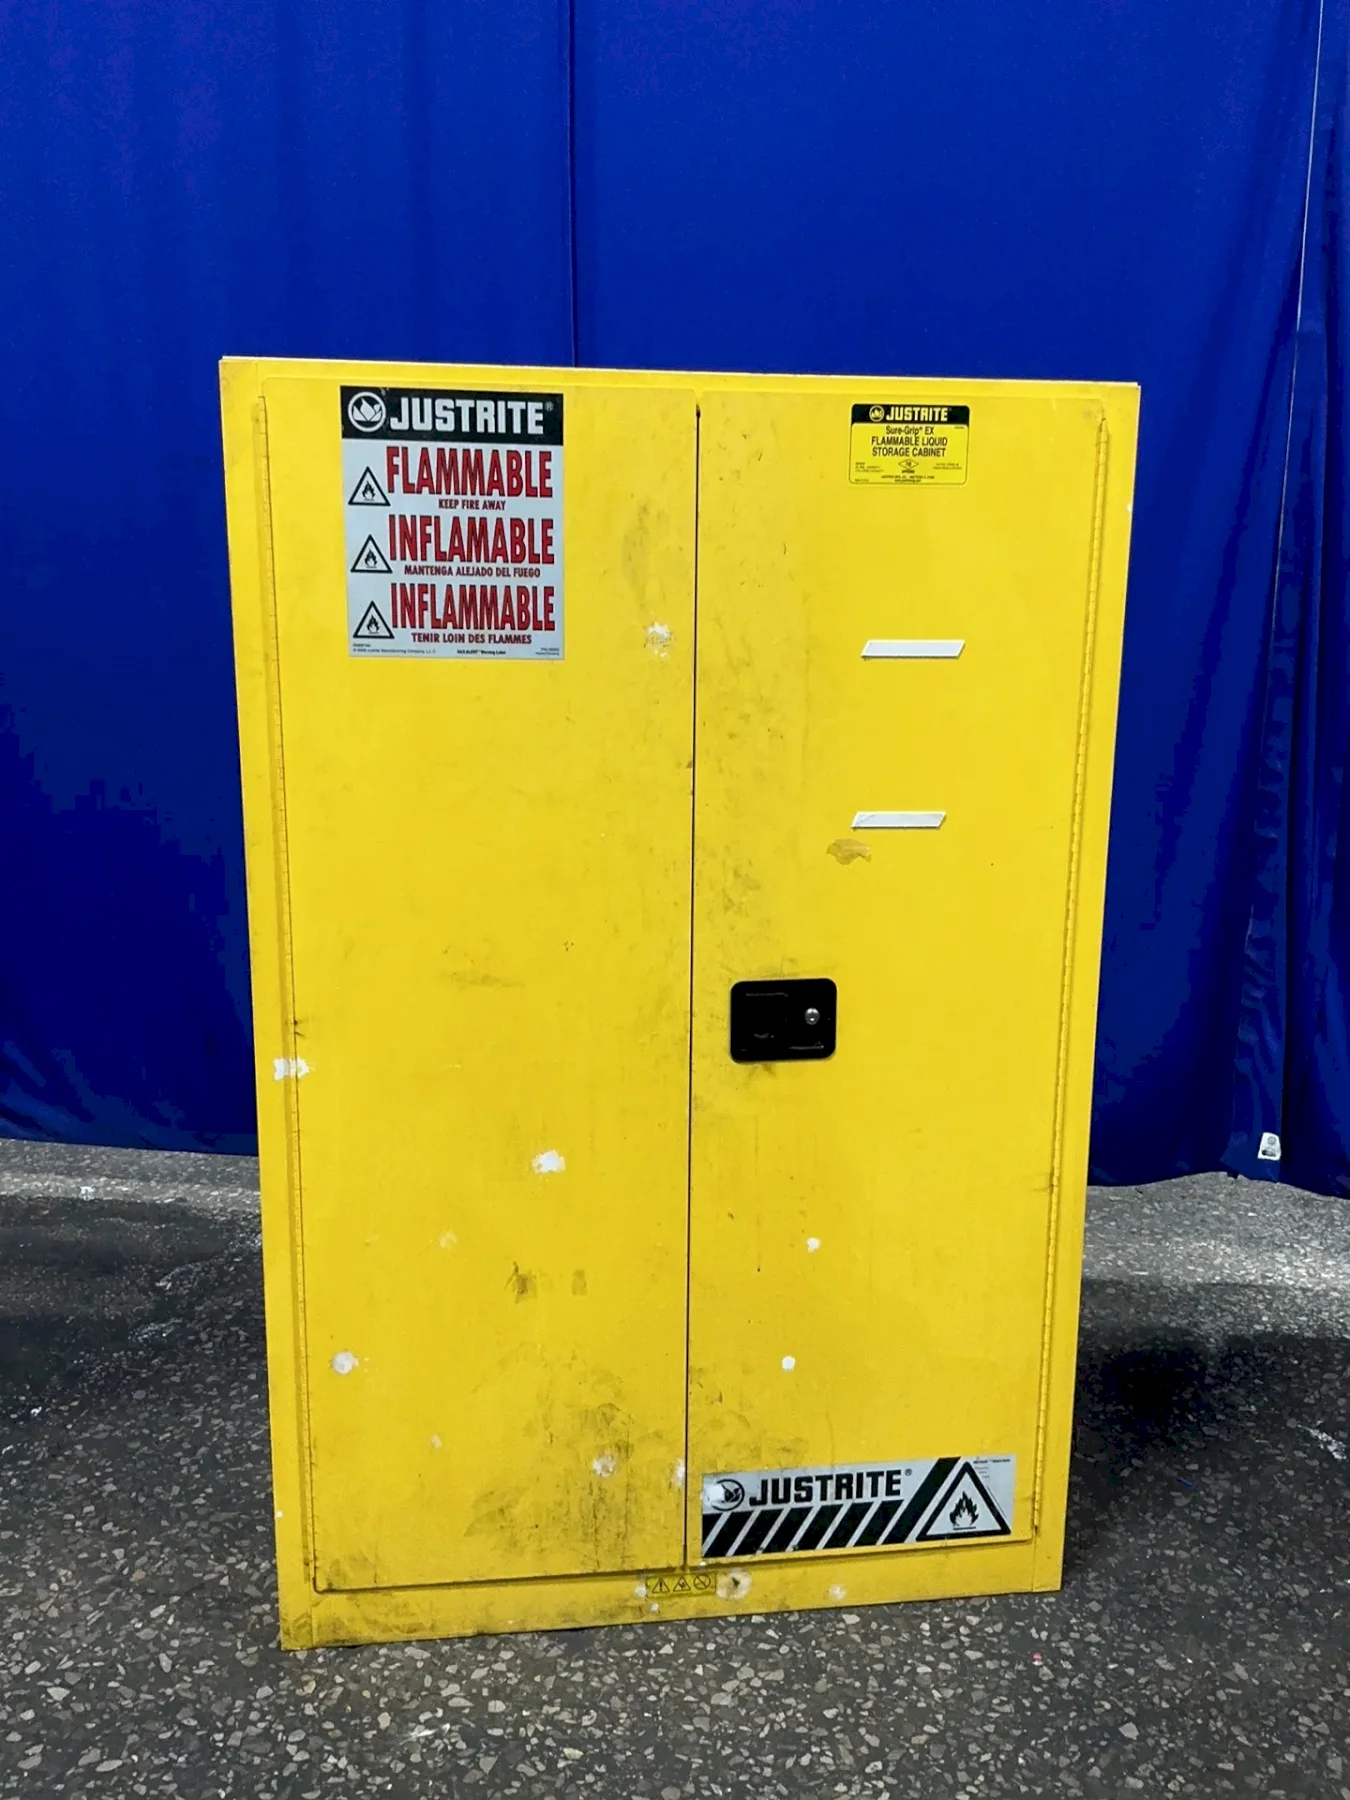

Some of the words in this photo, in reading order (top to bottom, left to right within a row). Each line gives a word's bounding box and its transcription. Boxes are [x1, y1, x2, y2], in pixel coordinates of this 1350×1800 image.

[925, 426, 934, 435] EX
[871, 436, 919, 446] FLAMMABLE
[922, 437, 947, 447] LIQUID
[872, 447, 909, 457] STORAGE
[912, 448, 946, 458] CABINET
[386, 446, 553, 498] FLAMMABLE
[438, 499, 459, 510] KEEP
[462, 499, 480, 510] FIRE
[482, 500, 506, 511] AWAY
[389, 514, 555, 564] INFLAMABLE
[404, 565, 453, 577] MANTENGA
[456, 566, 493, 577] ALEJADO
[496, 567, 511, 577] DEL
[514, 567, 541, 578] FUEGO
[391, 583, 555, 631] INFLAMMABLE
[412, 633, 440, 643] TENIR
[443, 633, 465, 643] LOIN
[468, 634, 485, 644] DES
[488, 634, 531, 644] FLAMMES
